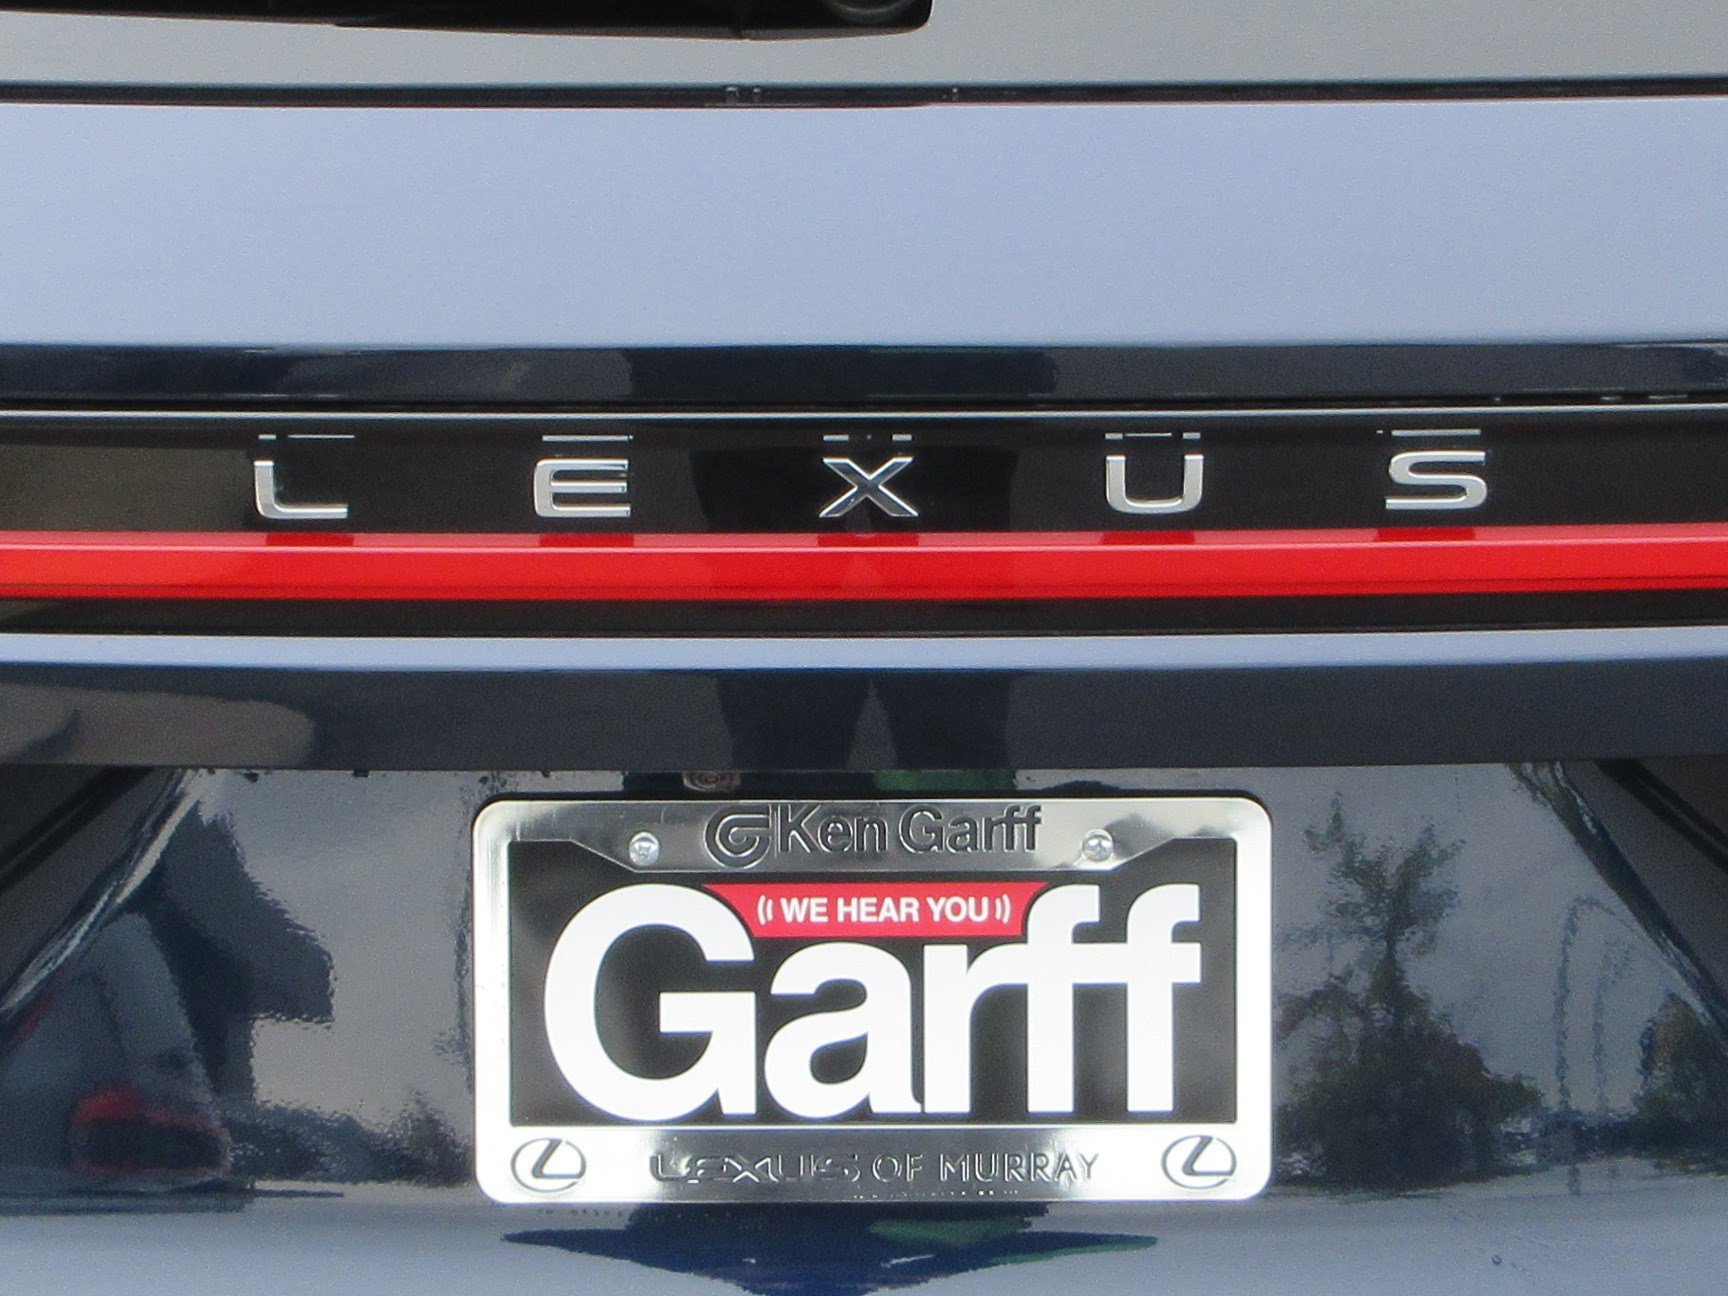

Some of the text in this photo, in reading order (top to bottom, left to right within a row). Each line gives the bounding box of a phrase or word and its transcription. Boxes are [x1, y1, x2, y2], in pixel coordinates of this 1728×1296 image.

[255, 450, 1488, 520] LEXUS
[778, 803, 1042, 855] Ken Garff
[780, 896, 989, 923] WE HEAR YOU
[544, 883, 1202, 1122] Garff
[650, 1152, 1100, 1184] LEXUS OF MURRAY
